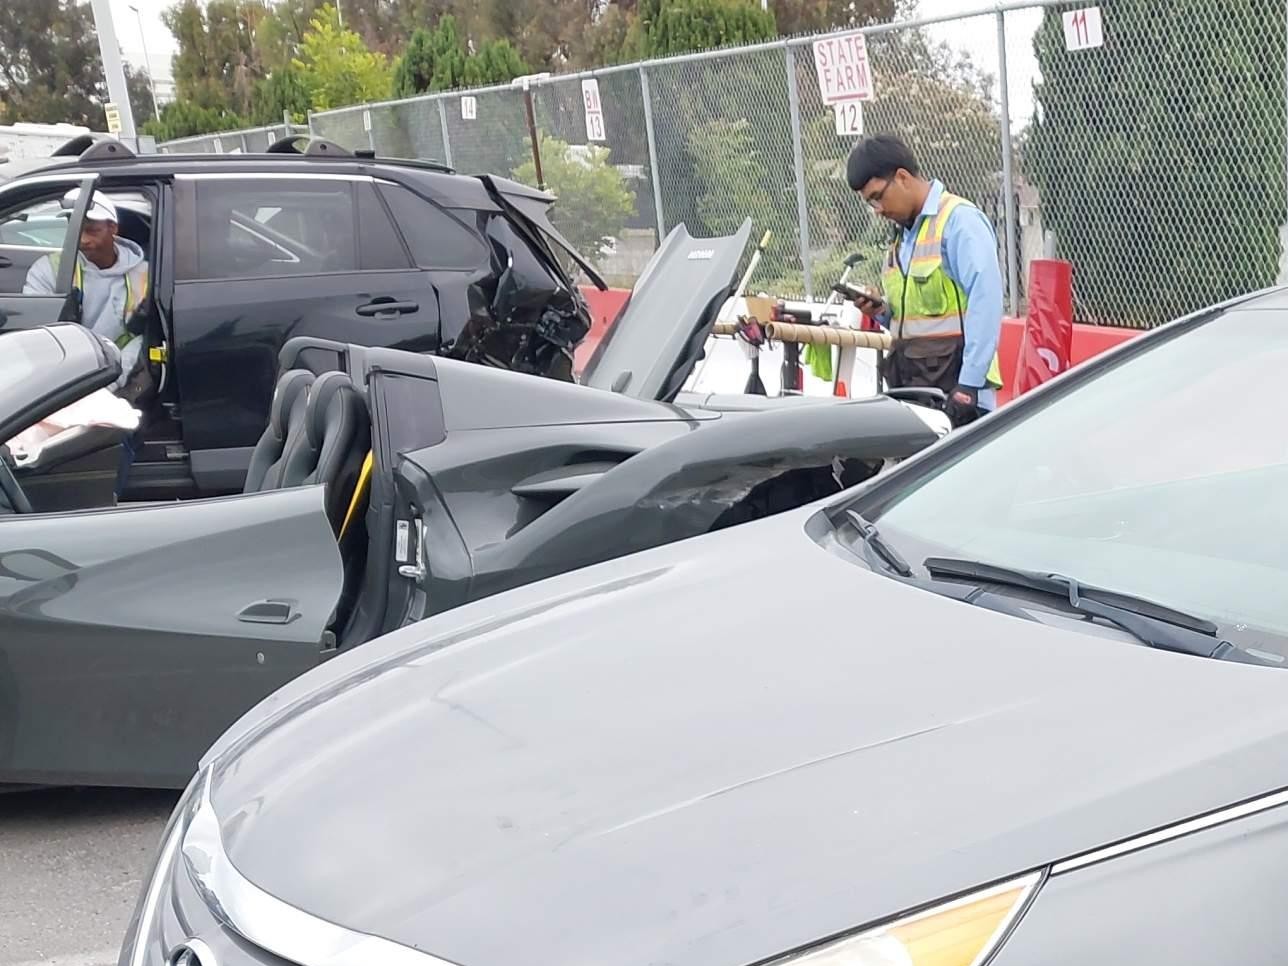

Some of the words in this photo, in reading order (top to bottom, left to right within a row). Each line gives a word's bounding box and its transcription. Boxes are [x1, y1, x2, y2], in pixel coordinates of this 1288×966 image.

[1071, 10, 1090, 47] 11
[817, 36, 865, 67] STATE
[823, 63, 869, 93] FARM
[590, 115, 602, 138] 13
[840, 103, 859, 133] 12
